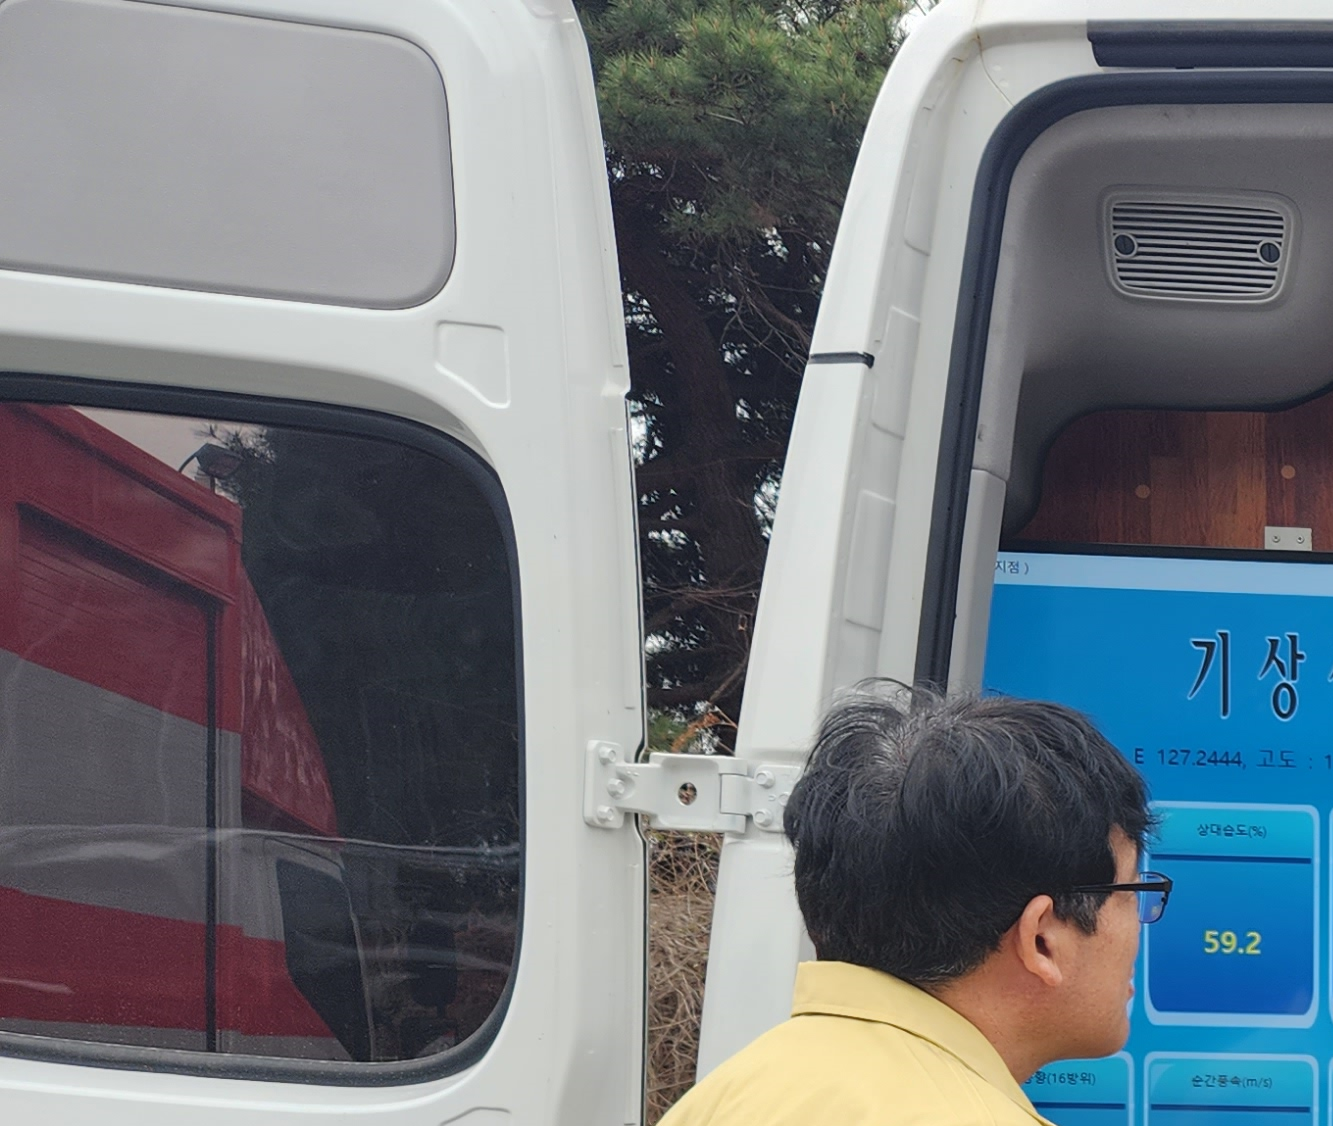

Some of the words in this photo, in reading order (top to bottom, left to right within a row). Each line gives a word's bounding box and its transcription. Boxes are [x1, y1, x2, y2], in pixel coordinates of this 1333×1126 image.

[1134, 748, 1145, 764] E
[1157, 749, 1247, 769] 127.2444,
[1256, 750, 1297, 769] 고도
[1196, 823, 1267, 838] 상대습도(%)
[1203, 930, 1262, 956] 59.2
[1191, 1074, 1273, 1089] 순간풍속(m/s)
